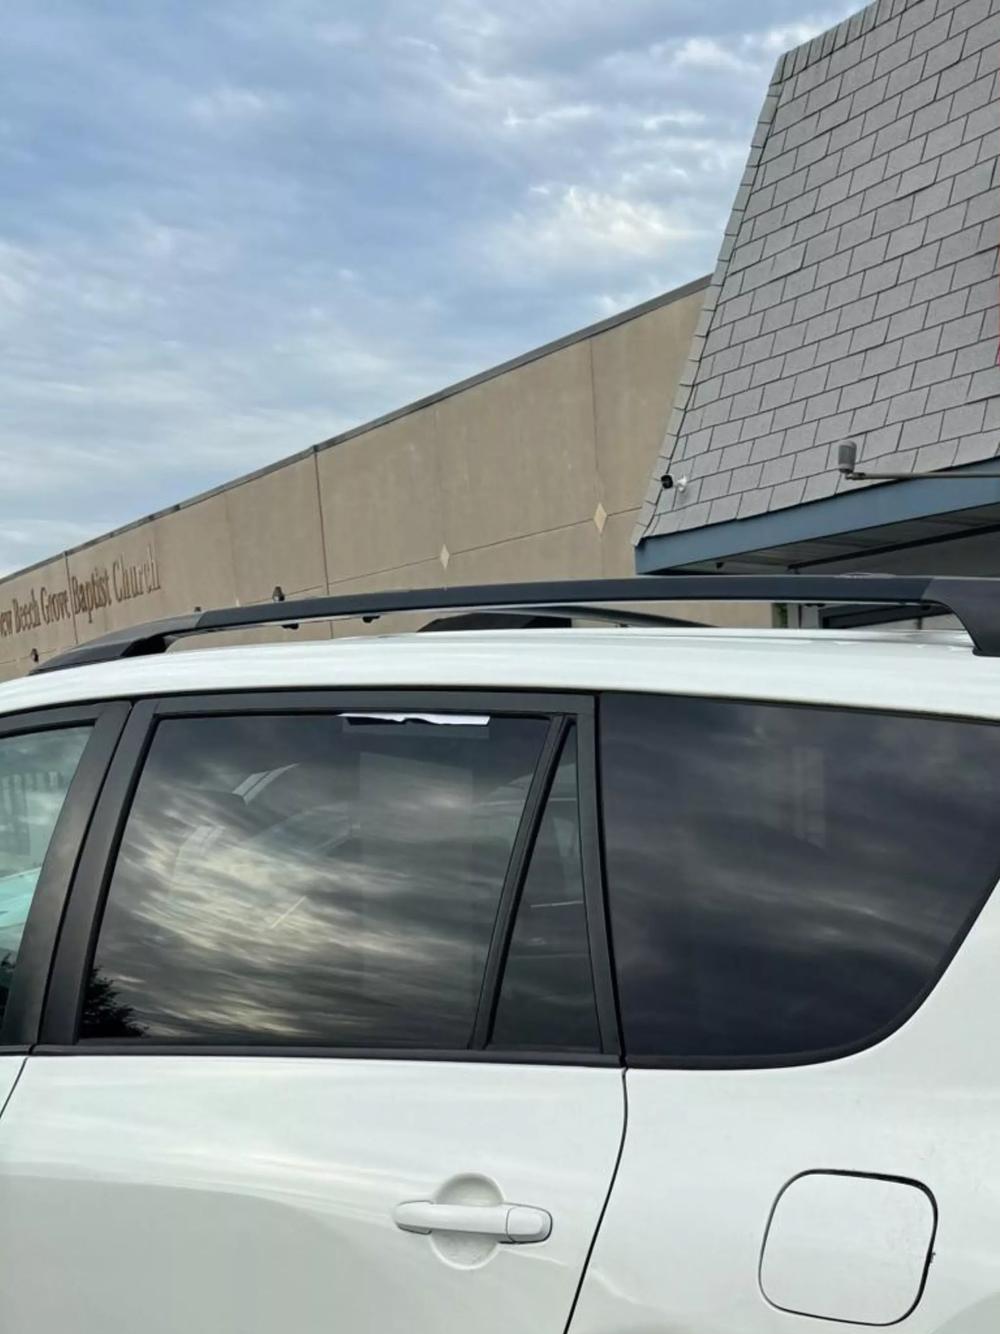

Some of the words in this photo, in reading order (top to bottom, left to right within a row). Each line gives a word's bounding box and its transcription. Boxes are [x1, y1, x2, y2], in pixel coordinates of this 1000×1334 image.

[12, 588, 41, 633] Beech
[40, 586, 71, 625] Grove
[71, 567, 112, 624] Baptist
[112, 544, 161, 602] Church
